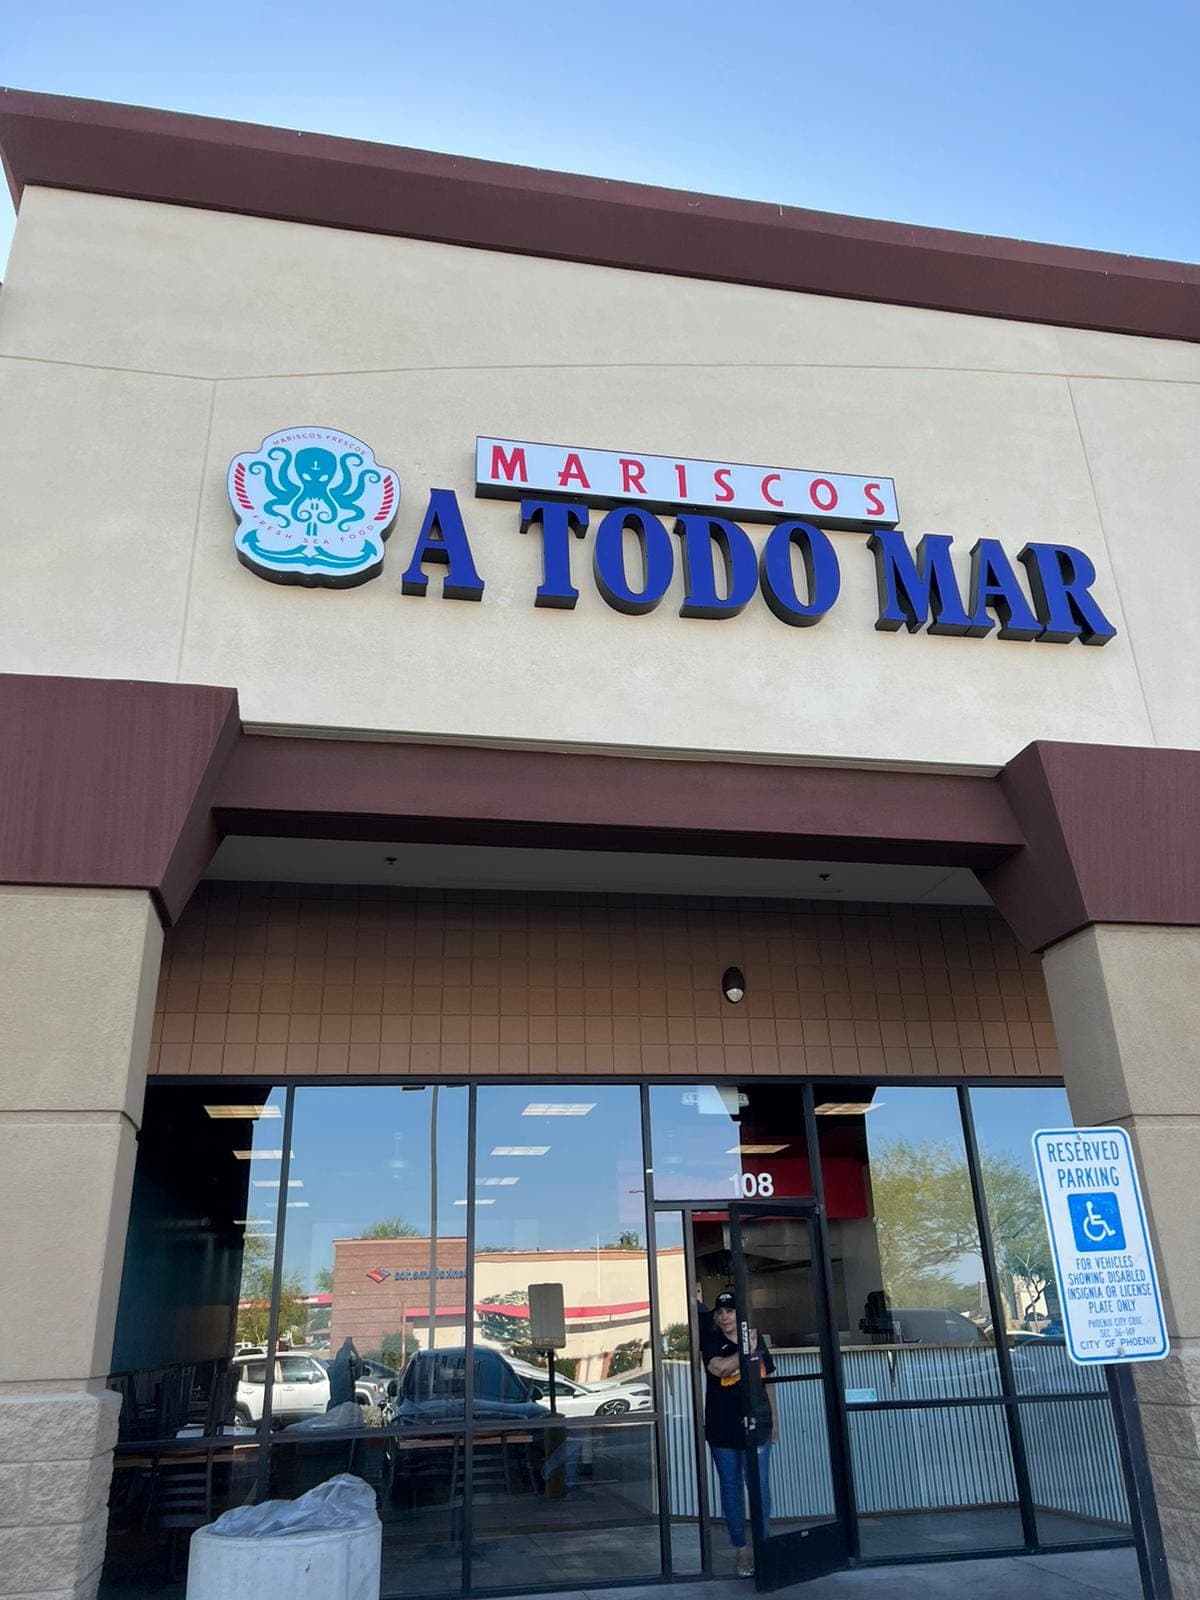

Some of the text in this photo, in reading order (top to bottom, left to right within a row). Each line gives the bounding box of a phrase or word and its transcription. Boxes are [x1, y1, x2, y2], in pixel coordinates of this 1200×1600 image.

[272, 433, 367, 456] MARISCOS FRESCOS
[490, 444, 886, 516] MARISCOS
[252, 514, 293, 540] FRESH
[340, 524, 374, 543] FOOD
[401, 487, 1117, 642] A TODO MAR
[1046, 1141, 1120, 1162] RESERVED
[729, 1172, 775, 1198] 108
[1057, 1166, 1120, 1188] PARKING
[1076, 1255, 1134, 1270] FOR VEHICLES
[1068, 1269, 1146, 1286] SHOWING DISABLED
[1067, 1283, 1152, 1300] INSIGNIA OR LICENSE
[1089, 1299, 1137, 1314] PLATE ONLY
[1088, 1316, 1143, 1328] PHOENIX CITY CODE
[1080, 1336, 1158, 1350] CITY OF PHOENIX
